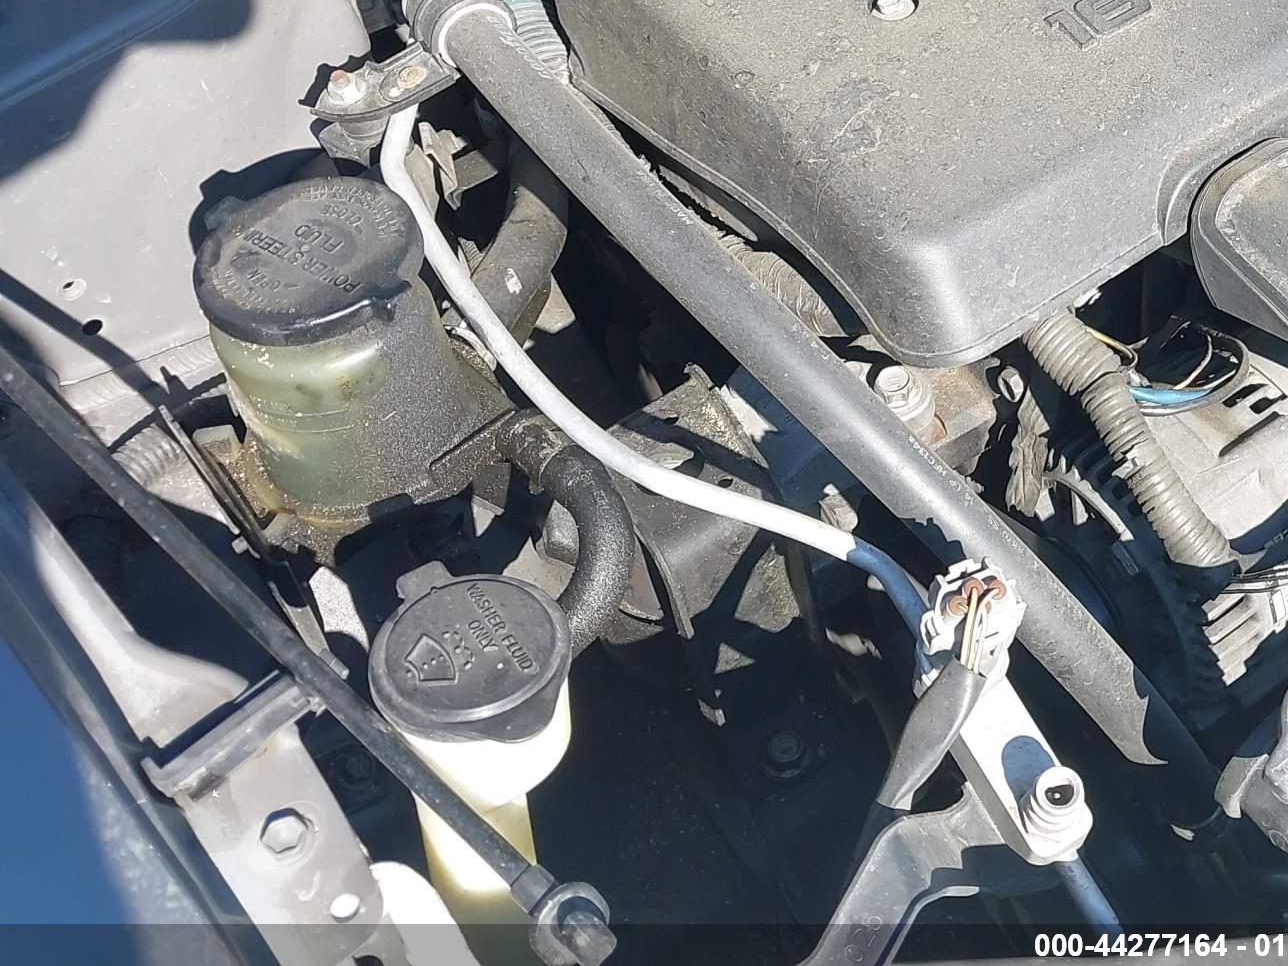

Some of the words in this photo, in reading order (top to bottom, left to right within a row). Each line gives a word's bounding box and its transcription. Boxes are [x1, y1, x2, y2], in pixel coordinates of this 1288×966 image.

[294, 224, 344, 254] FLUID
[302, 256, 361, 294] POWER
[467, 583, 506, 634] WASHER
[501, 634, 537, 673] FLUID
[467, 620, 498, 652] ONLY
